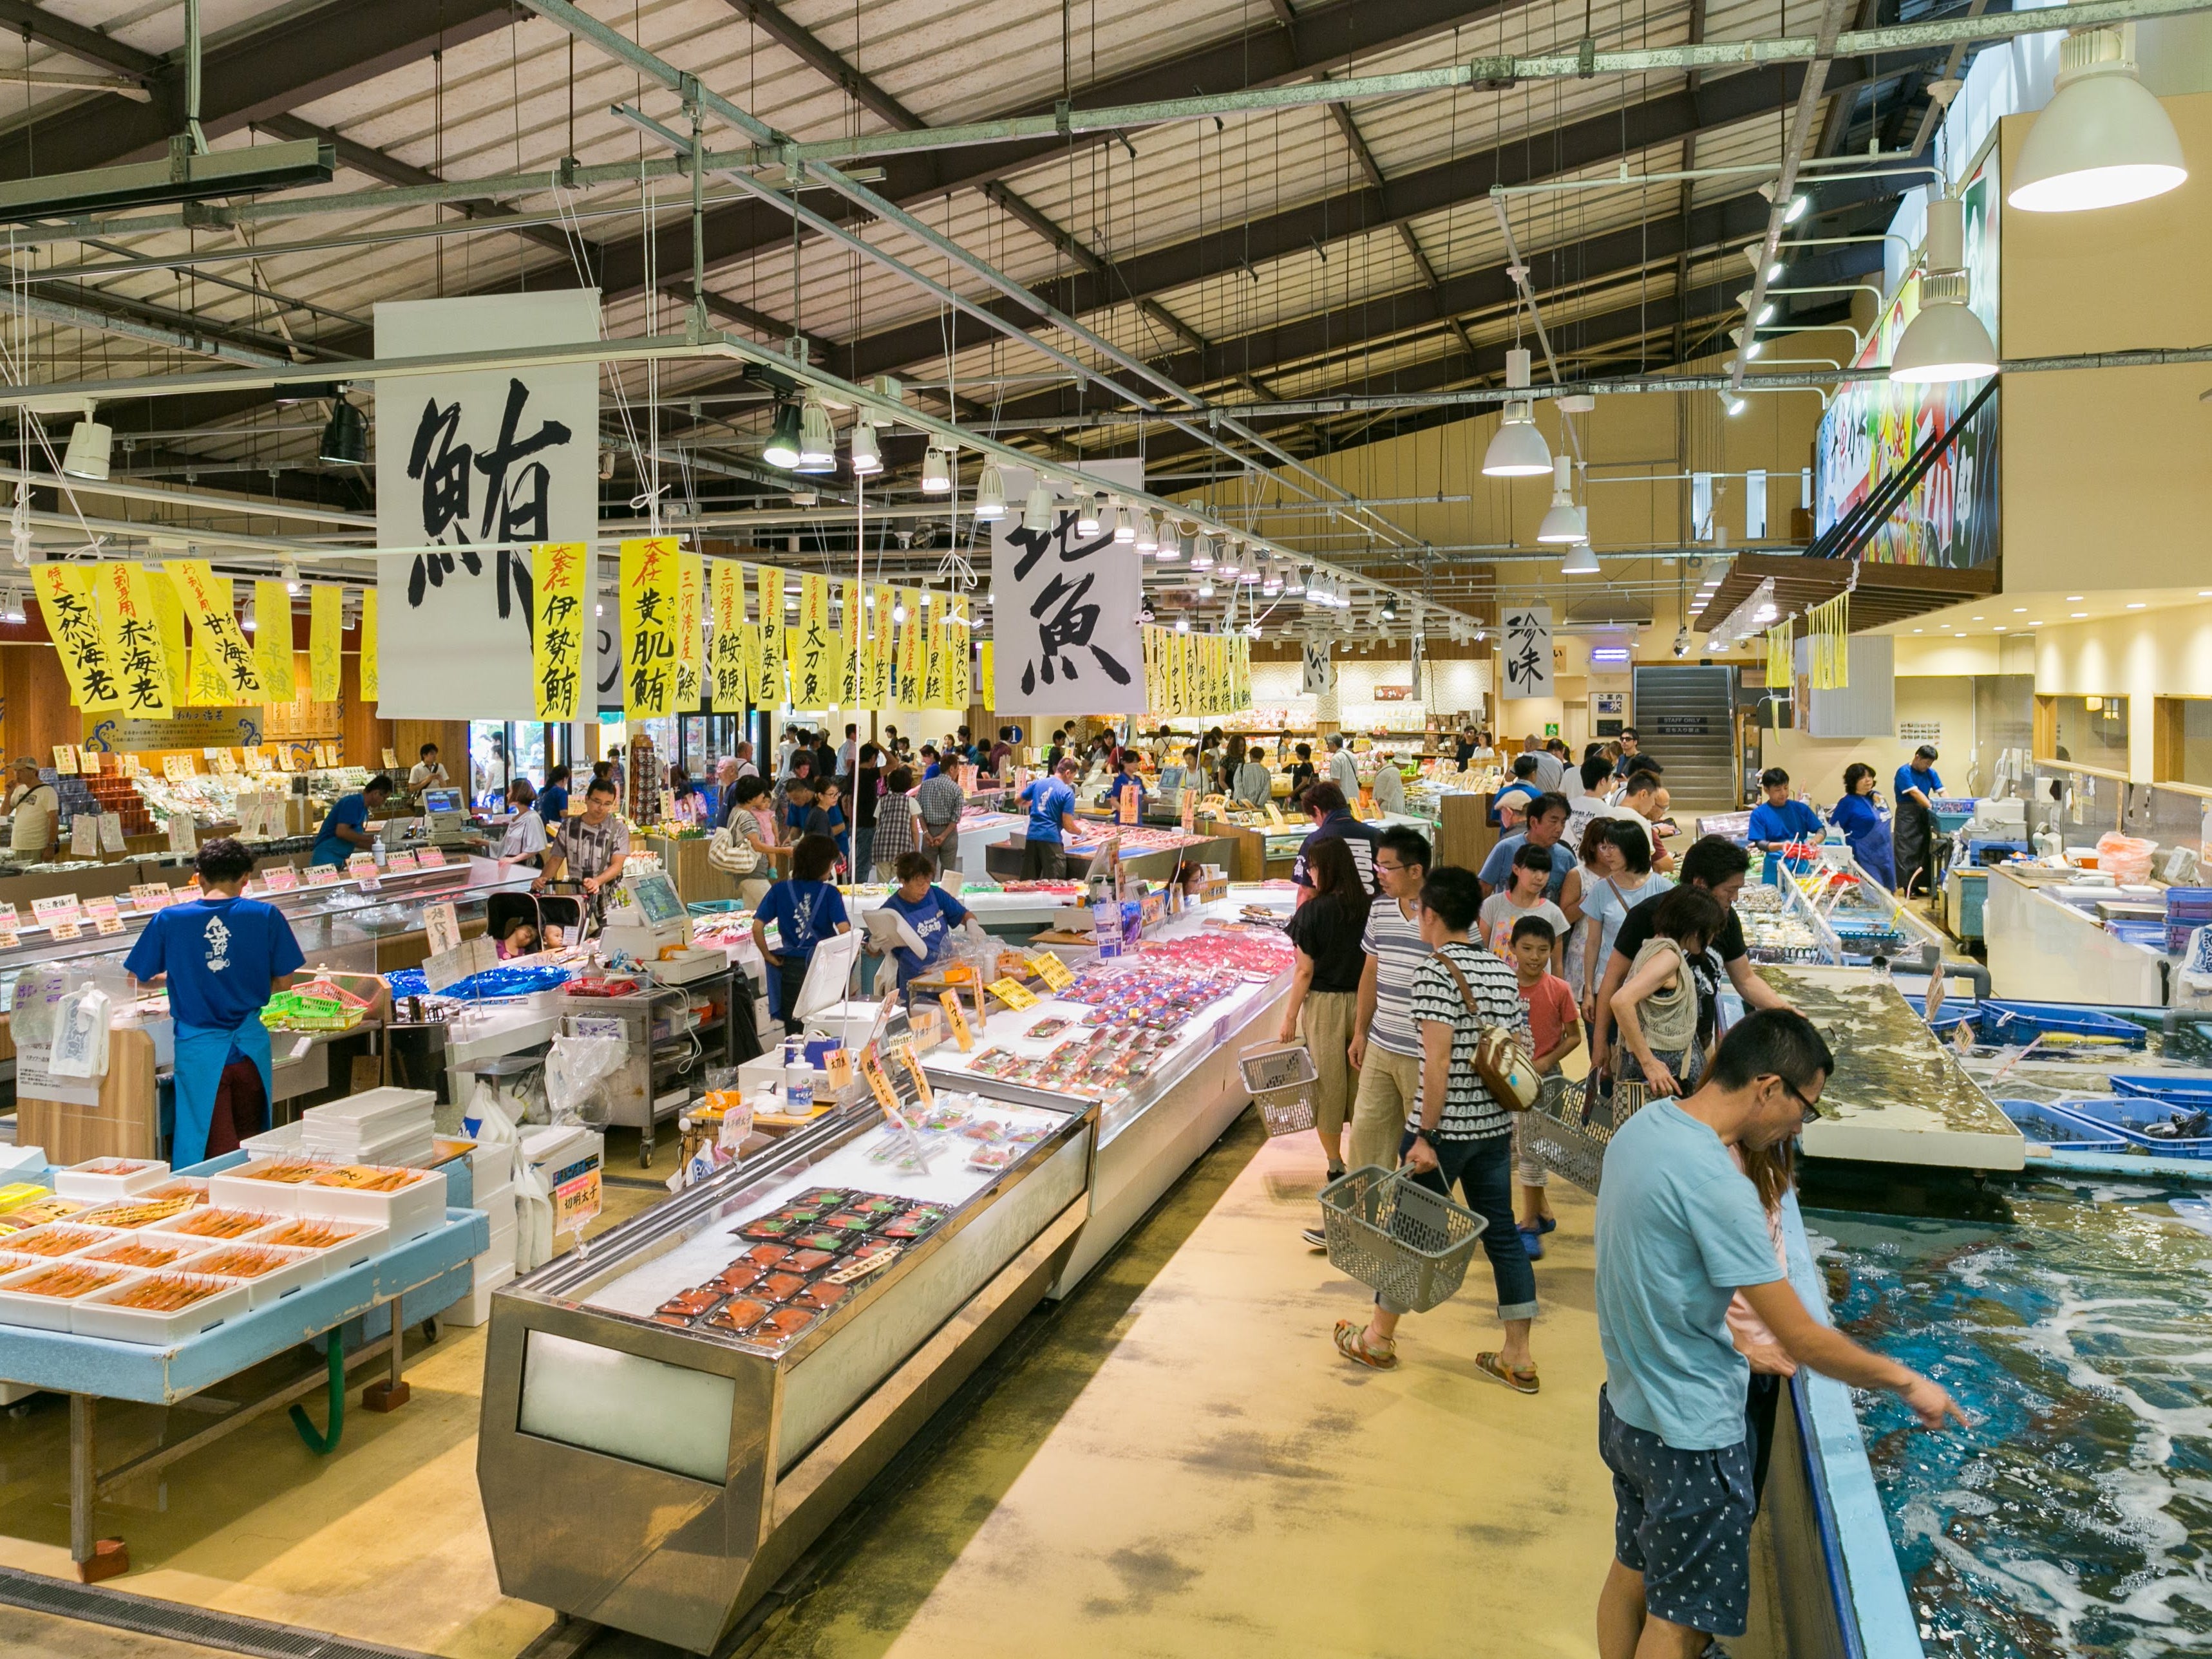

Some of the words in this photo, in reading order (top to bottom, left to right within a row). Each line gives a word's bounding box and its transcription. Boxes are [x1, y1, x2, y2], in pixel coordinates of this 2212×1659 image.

[408, 377, 573, 655] 鮪
[52, 594, 118, 704] 天然海老
[117, 618, 163, 709] 赤海老
[203, 614, 260, 691] 甘海老
[541, 595, 578, 718] 伊勢鮪
[629, 587, 674, 713] 黄肌鮪
[800, 619, 826, 705] 太刀魚
[1507, 612, 1547, 694] 珍味
[948, 1000, 962, 1030] ハマチ
[564, 1181, 598, 1209] 切明太子
